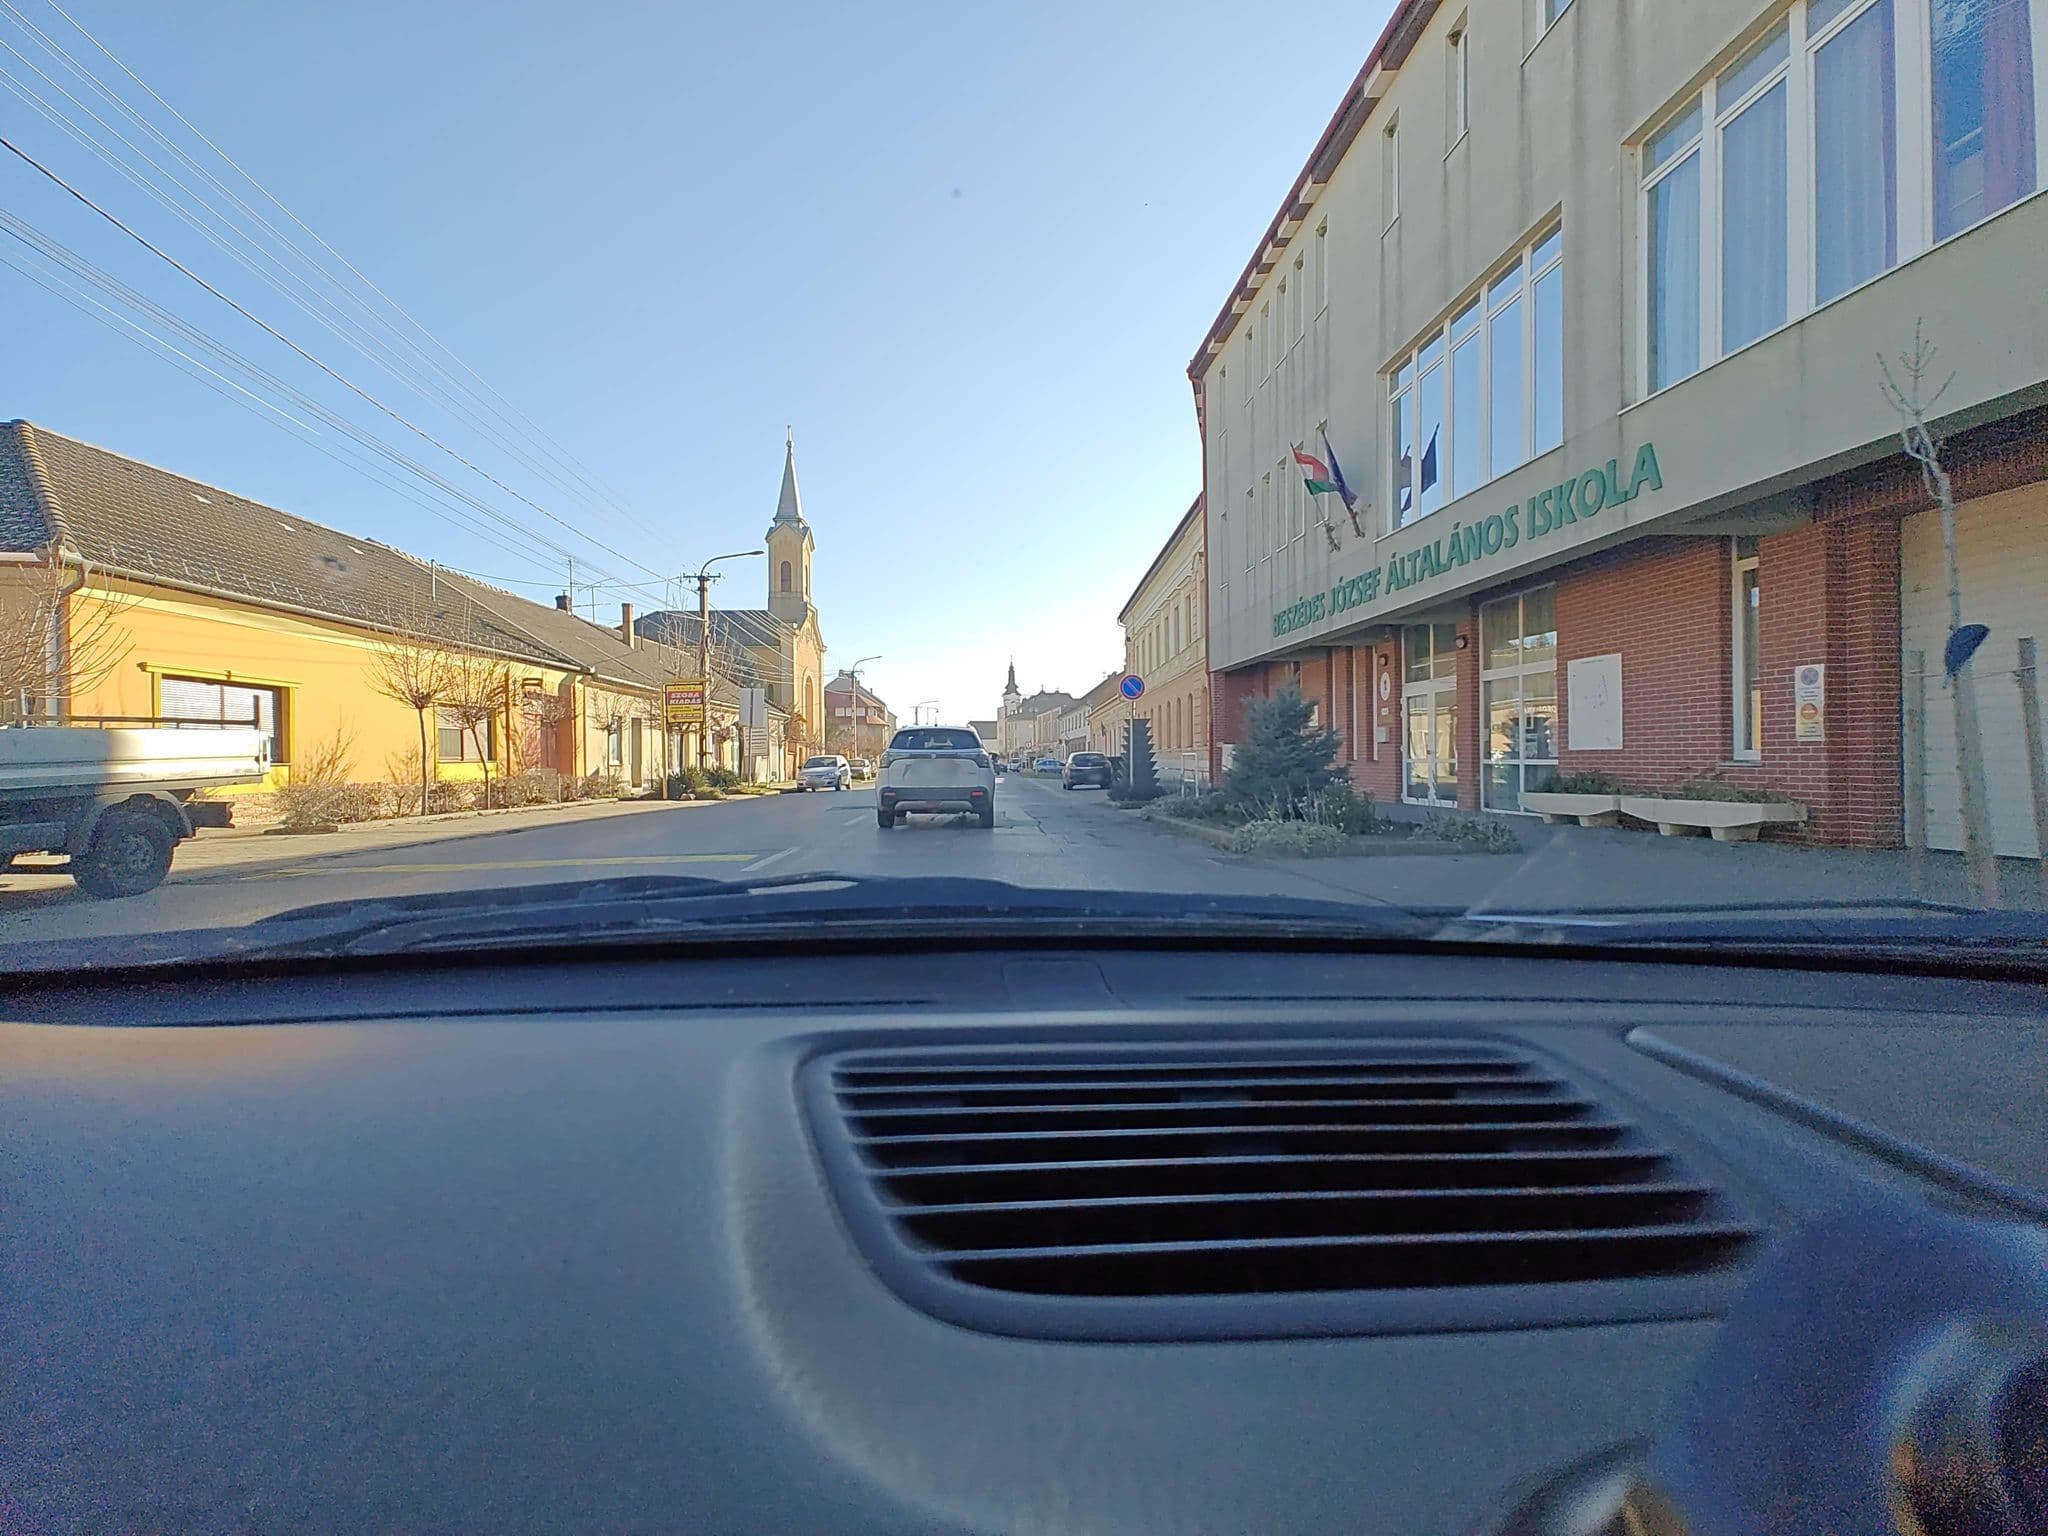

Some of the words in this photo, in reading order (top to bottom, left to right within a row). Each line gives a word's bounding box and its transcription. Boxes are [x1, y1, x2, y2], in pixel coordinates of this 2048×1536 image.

[1274, 592, 1325, 638] BESZÉDES
[1328, 566, 1381, 616] JÓZSEF
[1385, 505, 1519, 594] ÁLTALÁNOS
[1527, 442, 1663, 540] ISKOLA
